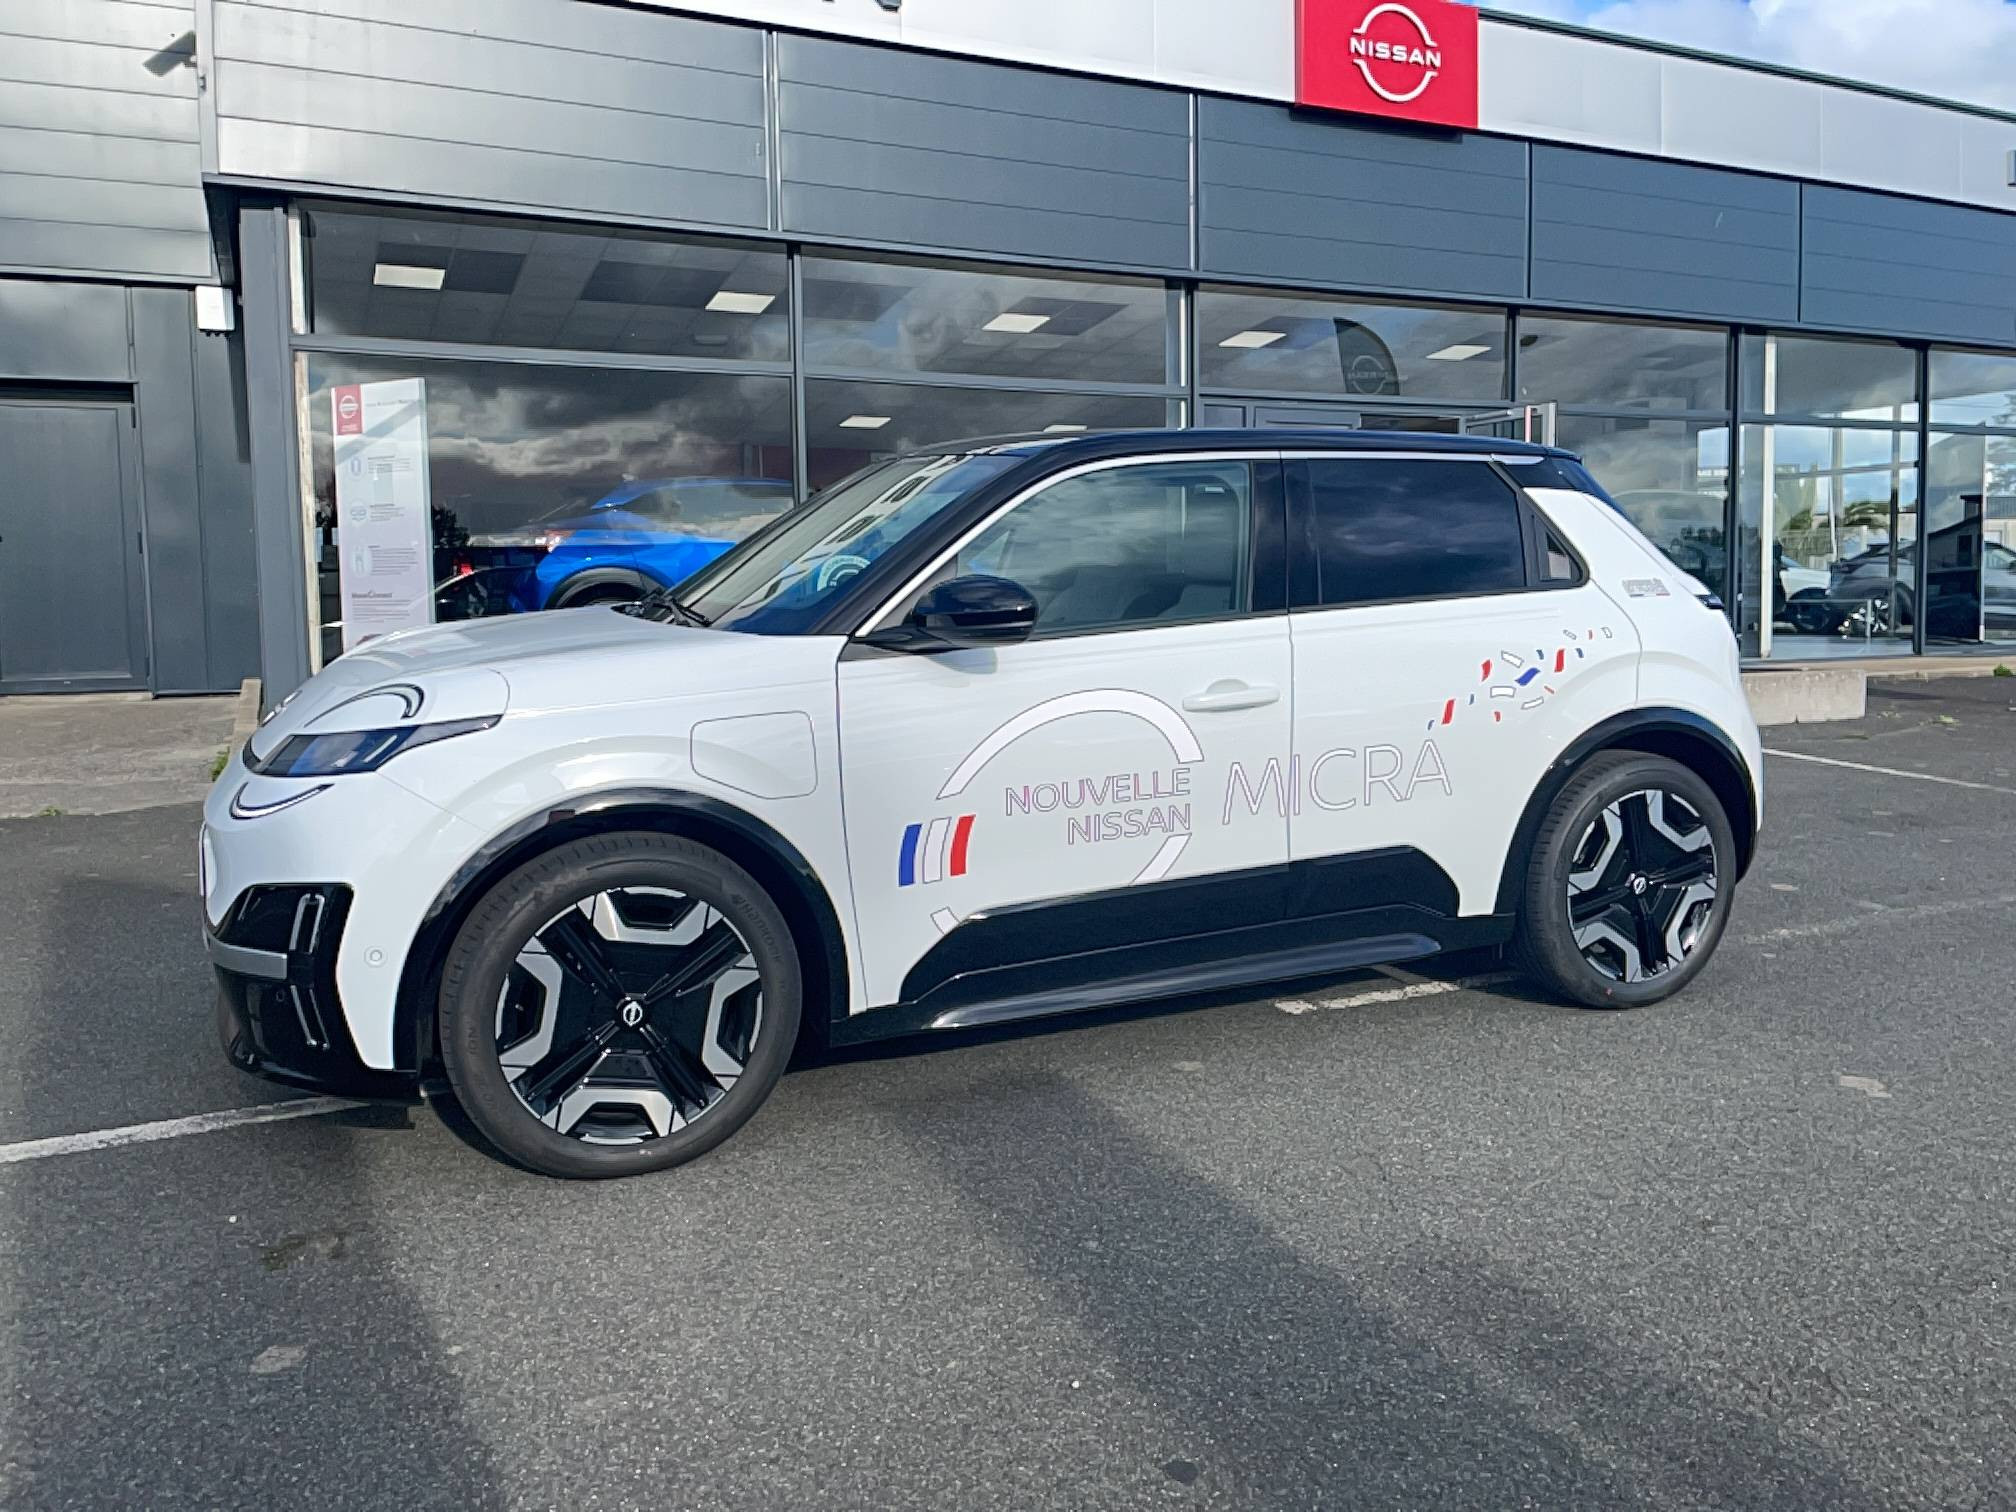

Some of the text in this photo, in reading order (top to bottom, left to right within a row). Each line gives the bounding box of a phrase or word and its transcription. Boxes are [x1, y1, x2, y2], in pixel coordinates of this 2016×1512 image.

[1349, 37, 1441, 68] NISSAN
[1005, 768, 1190, 816] NOUVELLE
[1222, 739, 1453, 825] MICRA
[1068, 803, 1190, 845] NISSAN
